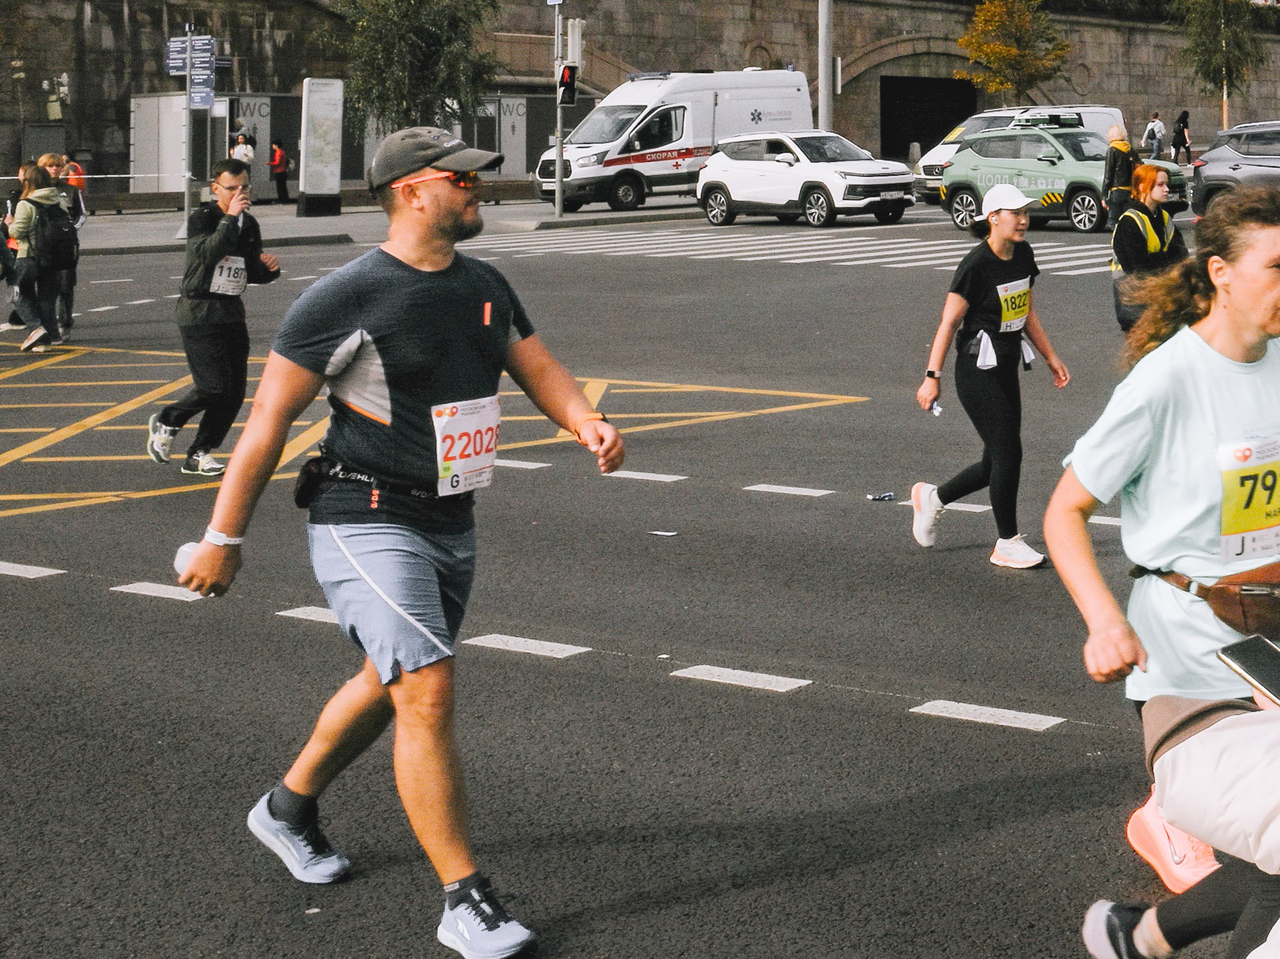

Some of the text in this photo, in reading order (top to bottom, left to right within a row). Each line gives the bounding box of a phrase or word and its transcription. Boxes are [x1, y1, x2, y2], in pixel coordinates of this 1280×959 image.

[240, 102, 270, 118] WC
[500, 102, 526, 117] WC
[645, 146, 678, 161] СКОРАЯ
[1003, 290, 1030, 313] 1822
[450, 474, 460, 489] G
[1235, 536, 1245, 556] J
